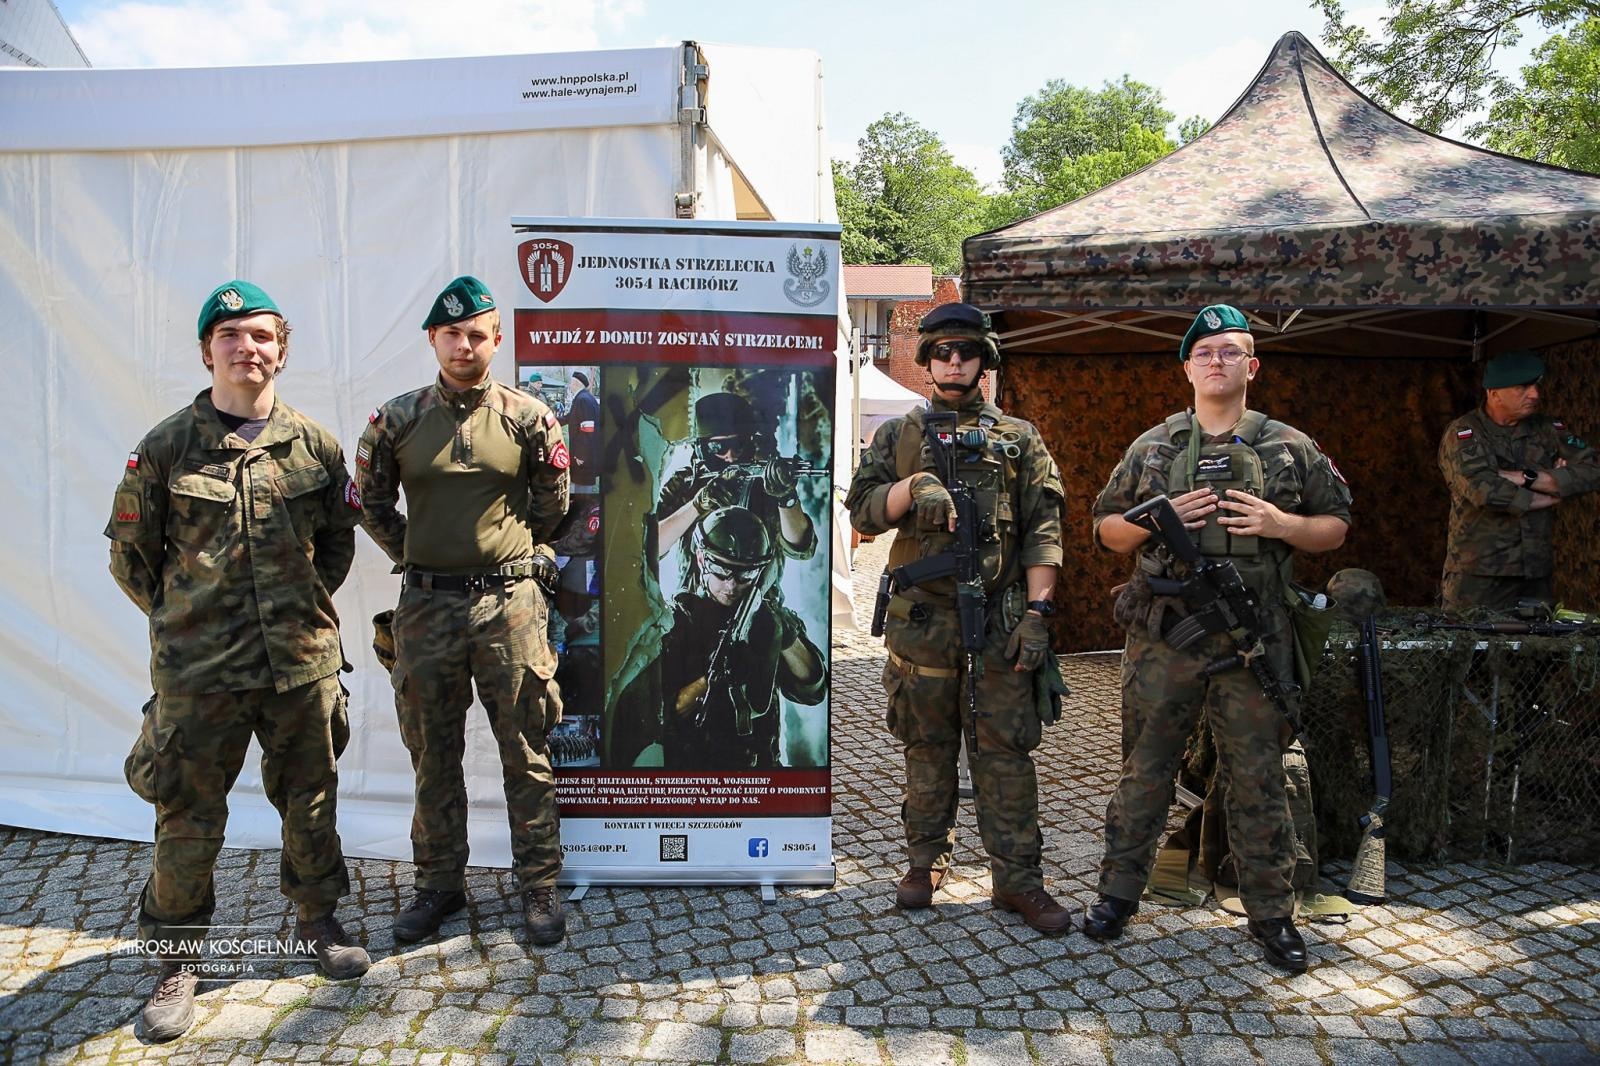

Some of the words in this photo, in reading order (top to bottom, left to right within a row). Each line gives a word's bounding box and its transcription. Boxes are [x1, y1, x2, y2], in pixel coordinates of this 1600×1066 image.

[531, 72, 629, 86] www.hnppolska.pl
[522, 83, 637, 99] www.hale-wynajem.pl
[532, 242, 559, 250] 3054
[577, 256, 671, 270] JEDNOSTKA
[675, 258, 775, 273] STRZELECKA
[615, 276, 653, 289] 3054
[658, 276, 738, 291] RACIBÓRZ
[529, 328, 581, 344] WYJDŹ
[585, 330, 595, 344] Z
[600, 330, 653, 345] DOMU!
[658, 330, 720, 346] ZOSTAŃ
[724, 333, 823, 350] STRZELCEM!
[581, 777, 596, 787] SIĘ
[597, 777, 653, 786] MILITARIAMI,
[654, 777, 721, 786] STRZELECTWEM,
[723, 777, 771, 785] WOJSKIEM?
[597, 787, 626, 796] SWOJĄ
[627, 787, 666, 796] KULTURĘ
[711, 785, 742, 795] POZNAĆ
[778, 786, 826, 794] PODOBNYCH
[613, 795, 649, 804] PRZEŻYĆ
[650, 797, 697, 806] PRZYGODĘ?
[699, 796, 727, 806] WSTĄP
[742, 796, 761, 804] NAS.
[604, 821, 646, 829] KONTAKT
[654, 821, 686, 831] WIĘCEJ
[687, 821, 743, 829] SZCZEGÓŁÓW
[782, 843, 816, 852] JS3054
